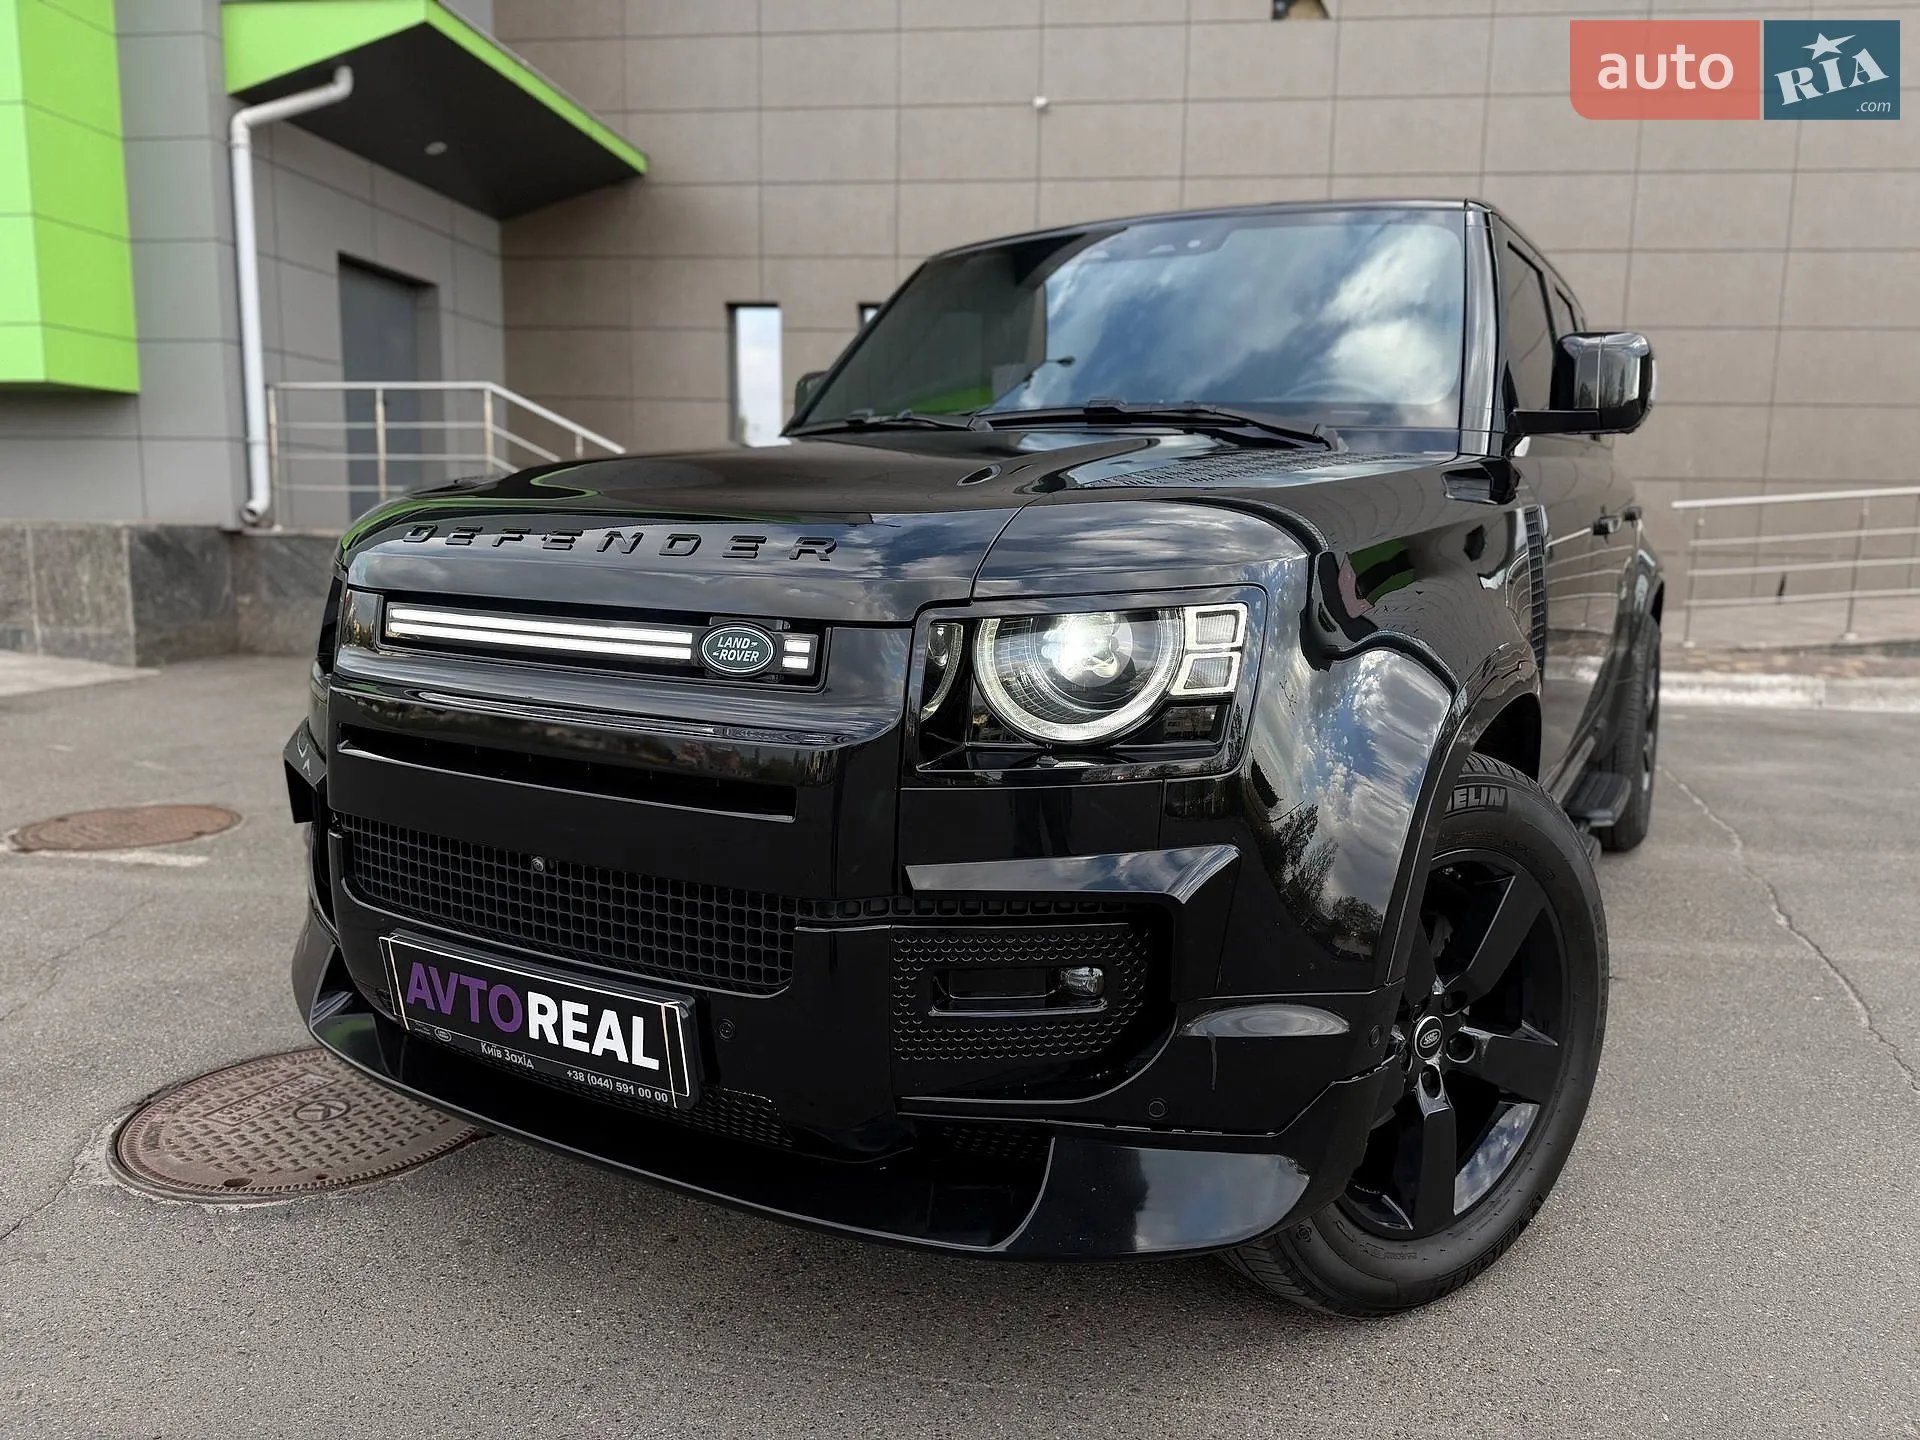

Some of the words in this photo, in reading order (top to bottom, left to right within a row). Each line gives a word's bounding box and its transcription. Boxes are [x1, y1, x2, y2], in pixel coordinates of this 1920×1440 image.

[402, 524, 837, 561] DEFENDER
[406, 961, 660, 1071] AVTOREAL
[480, 1042, 502, 1058] Київ
[504, 1049, 535, 1069] Захід
[566, 1069, 585, 1082] +38
[587, 1073, 613, 1091] (044)
[616, 1082, 636, 1095] 591
[638, 1087, 652, 1099] 00
[654, 1092, 668, 1103] 00
